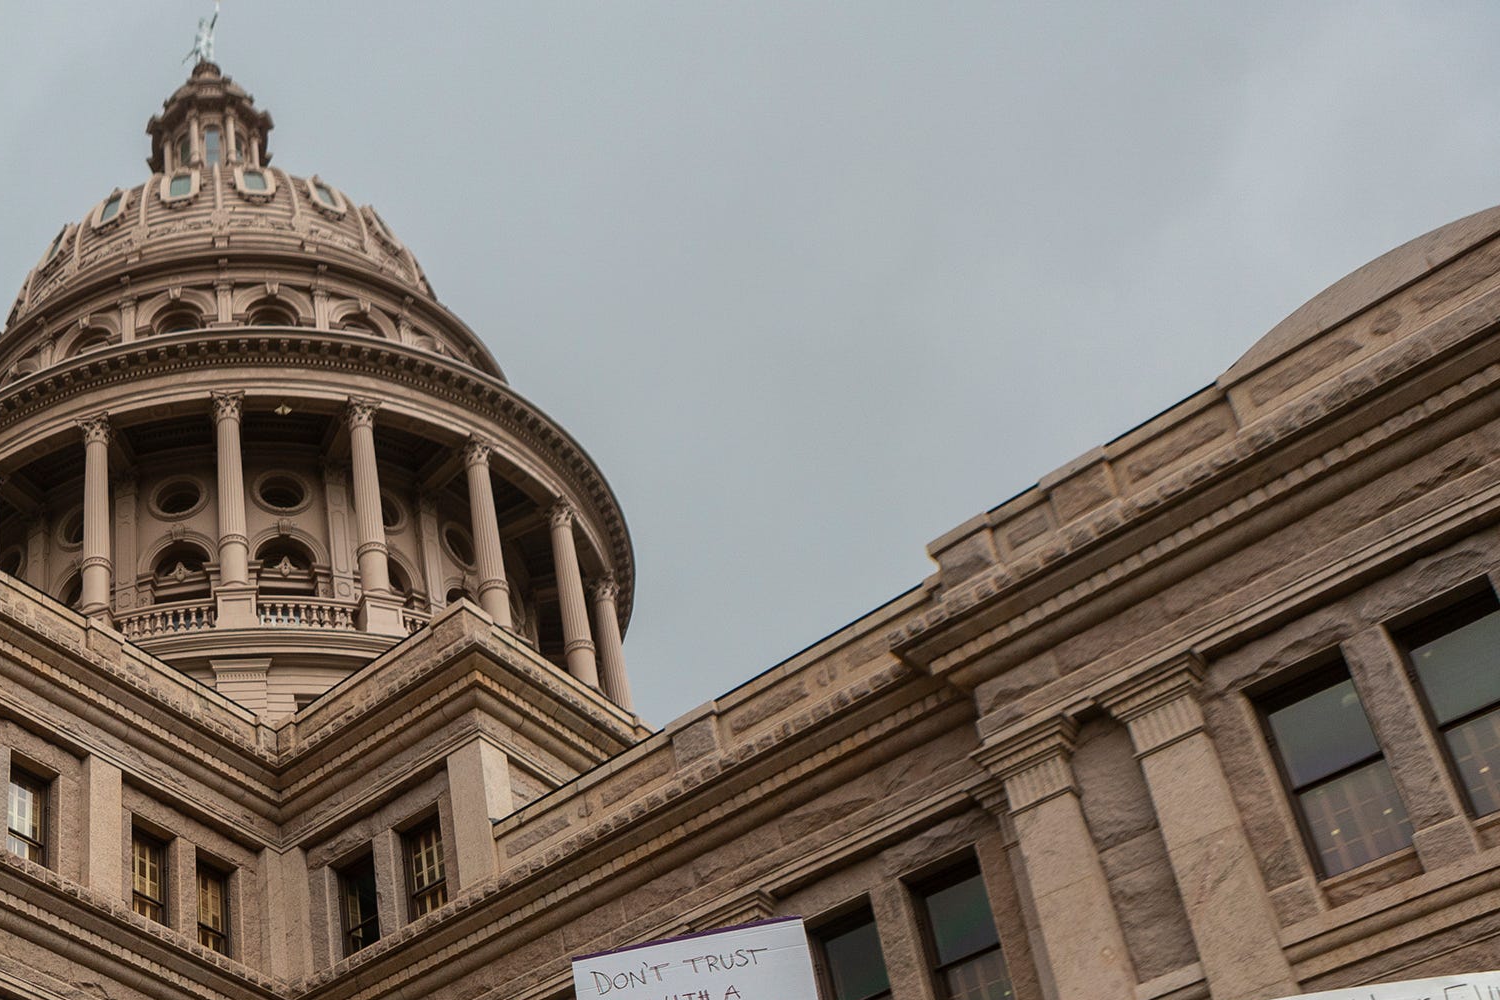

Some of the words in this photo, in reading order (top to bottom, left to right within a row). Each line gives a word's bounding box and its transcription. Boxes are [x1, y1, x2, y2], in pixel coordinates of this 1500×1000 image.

[590, 961, 670, 996] DON'T
[683, 947, 768, 974] TRUST
[723, 984, 742, 1000] A
